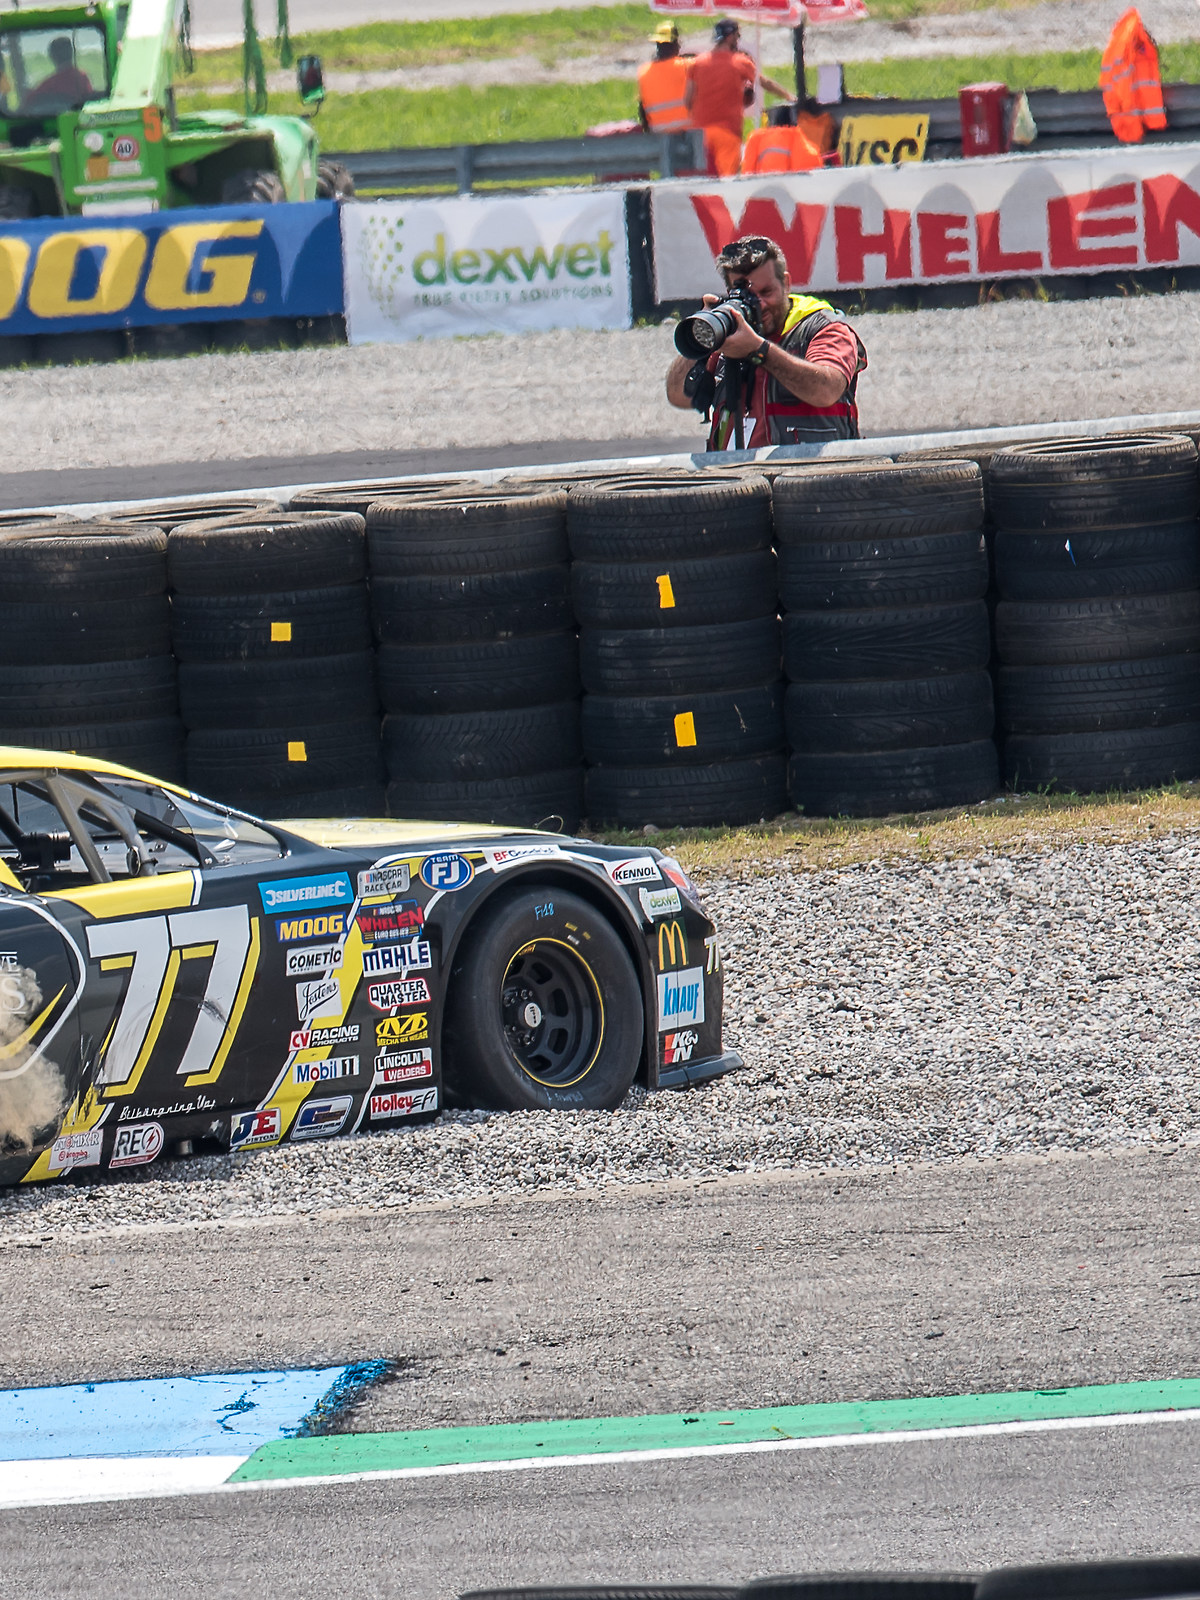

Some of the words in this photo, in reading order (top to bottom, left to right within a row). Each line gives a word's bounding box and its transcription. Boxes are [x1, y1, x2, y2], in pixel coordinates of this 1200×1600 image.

[117, 144, 132, 154] 40
[412, 230, 614, 286] dexwet
[372, 869, 402, 881] NASCAR
[432, 861, 460, 886] FJ
[615, 867, 656, 880] KENNOL
[365, 883, 384, 893] RACE
[386, 881, 402, 891] CAR
[279, 914, 344, 941] MOOG
[356, 906, 424, 934] WHELEN
[289, 947, 342, 969] COMETIC
[362, 943, 429, 971] MAHLE
[86, 904, 259, 1097] 77
[370, 980, 424, 1001] QUARTER
[381, 990, 427, 1007] MASTER
[663, 977, 700, 1020] KNAUF
[292, 1032, 310, 1048] CV
[312, 1025, 360, 1042] RACING
[312, 1035, 359, 1047] PRODUCTS
[296, 1060, 337, 1083] Mobil
[377, 1052, 421, 1071] LINCOLN
[388, 1065, 427, 1081] WELDERS
[372, 1093, 413, 1114] Holley
[231, 1110, 277, 1145] JE
[245, 1133, 280, 1144] PISTONS
